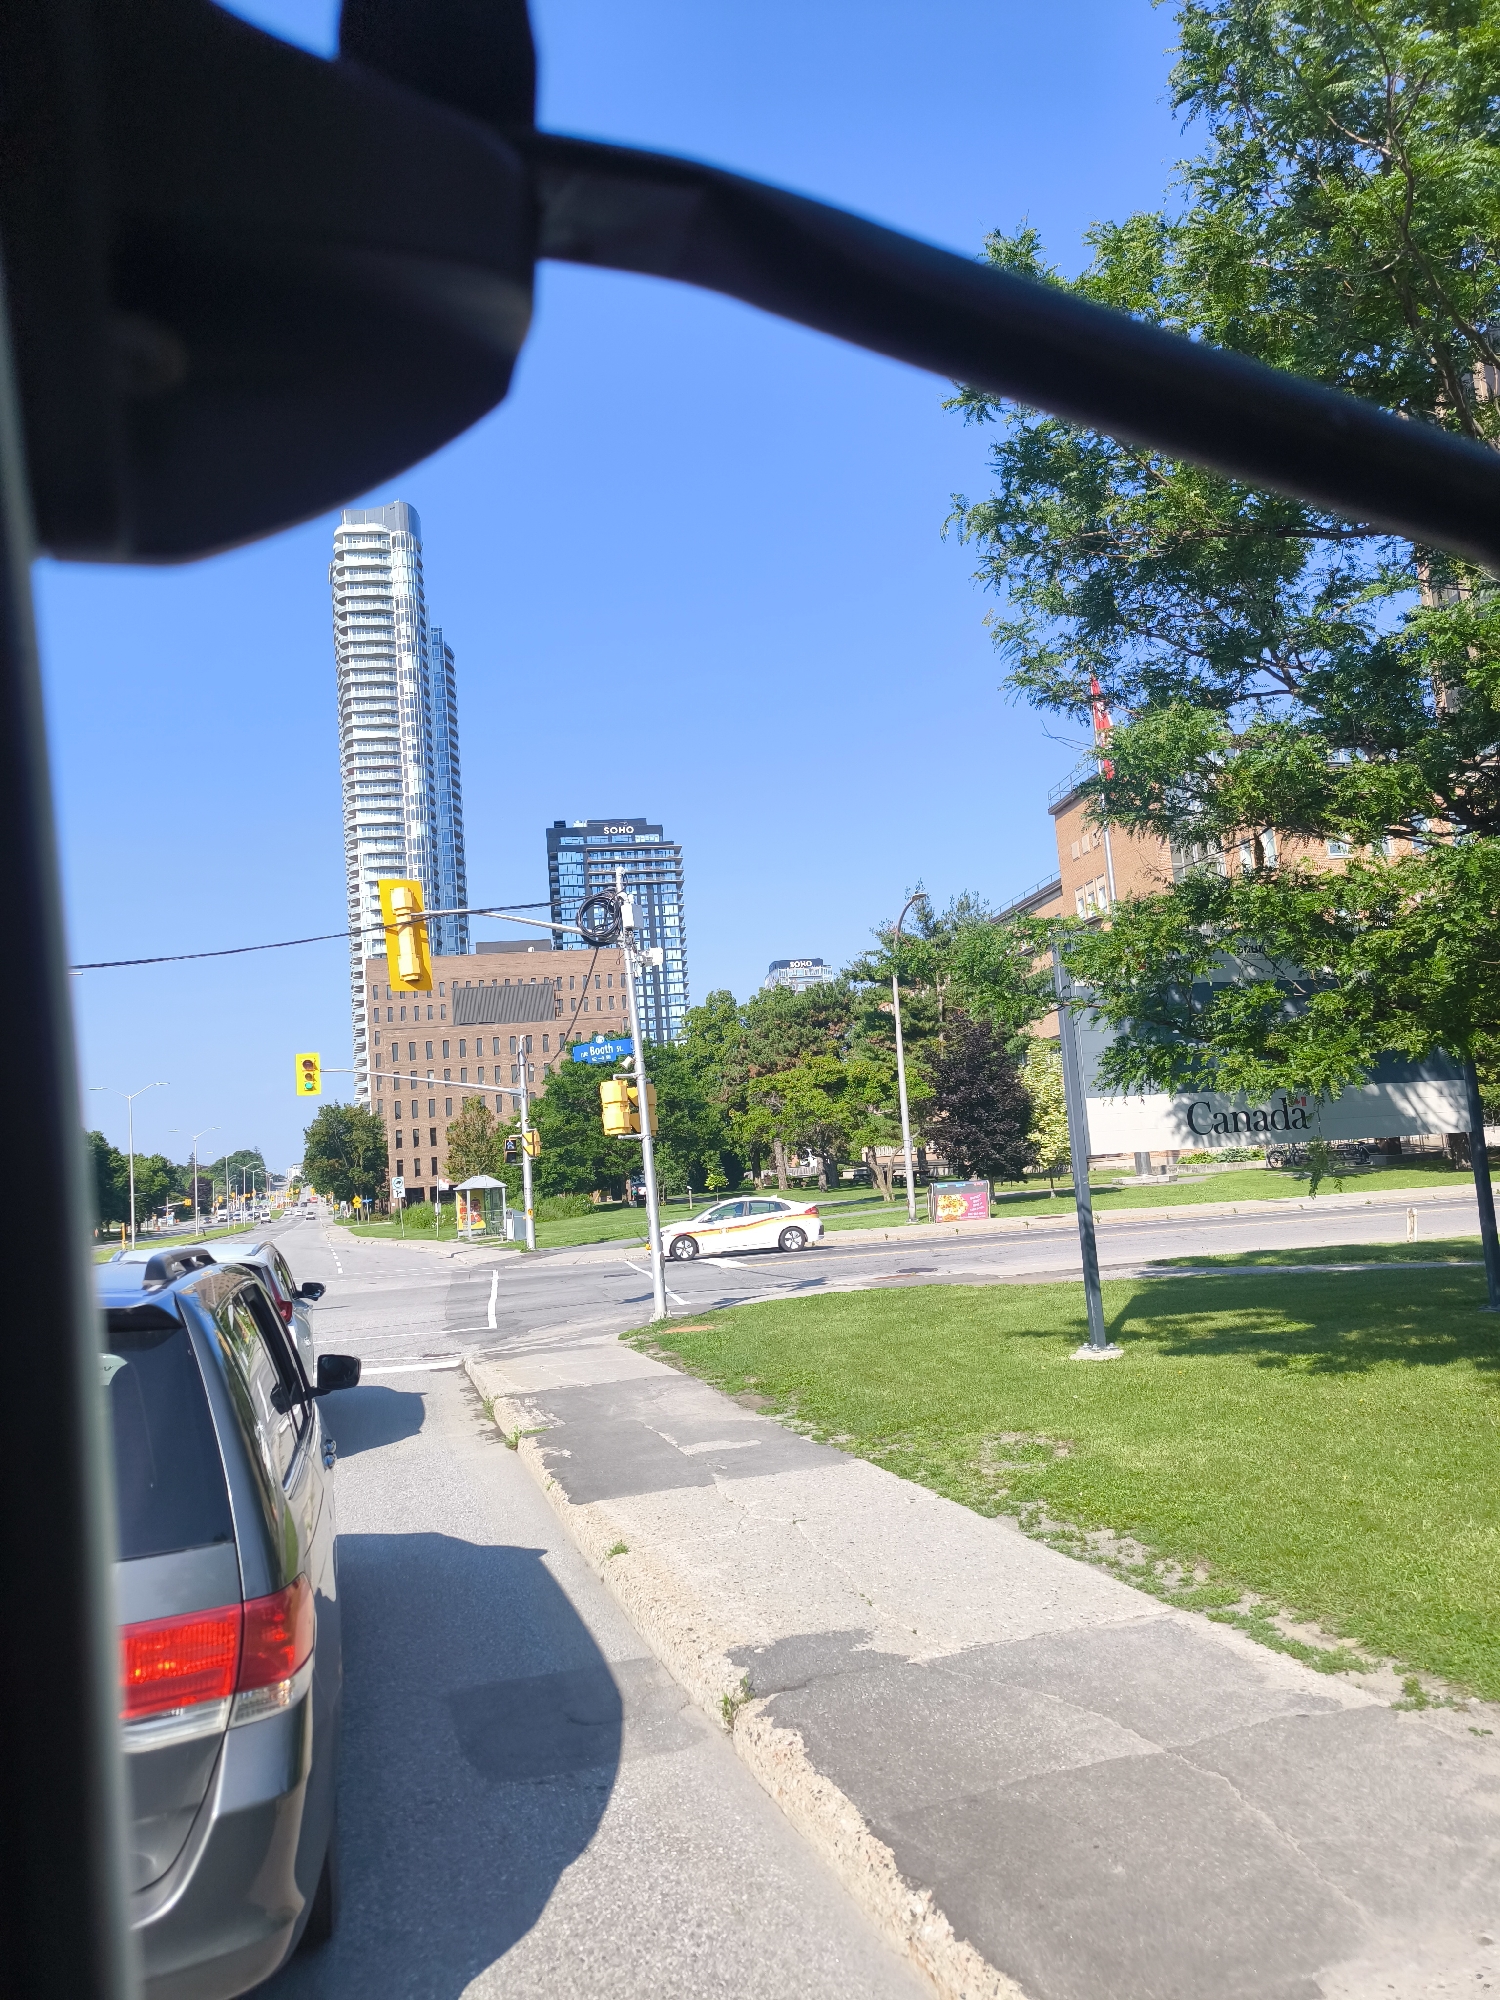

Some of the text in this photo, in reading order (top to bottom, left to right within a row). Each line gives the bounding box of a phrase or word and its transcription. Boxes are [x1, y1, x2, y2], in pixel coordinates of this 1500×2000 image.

[603, 826, 634, 834] SOHO
[790, 960, 812, 968] SOHO
[589, 1043, 613, 1056] Booth
[1187, 1097, 1311, 1135] Canada
